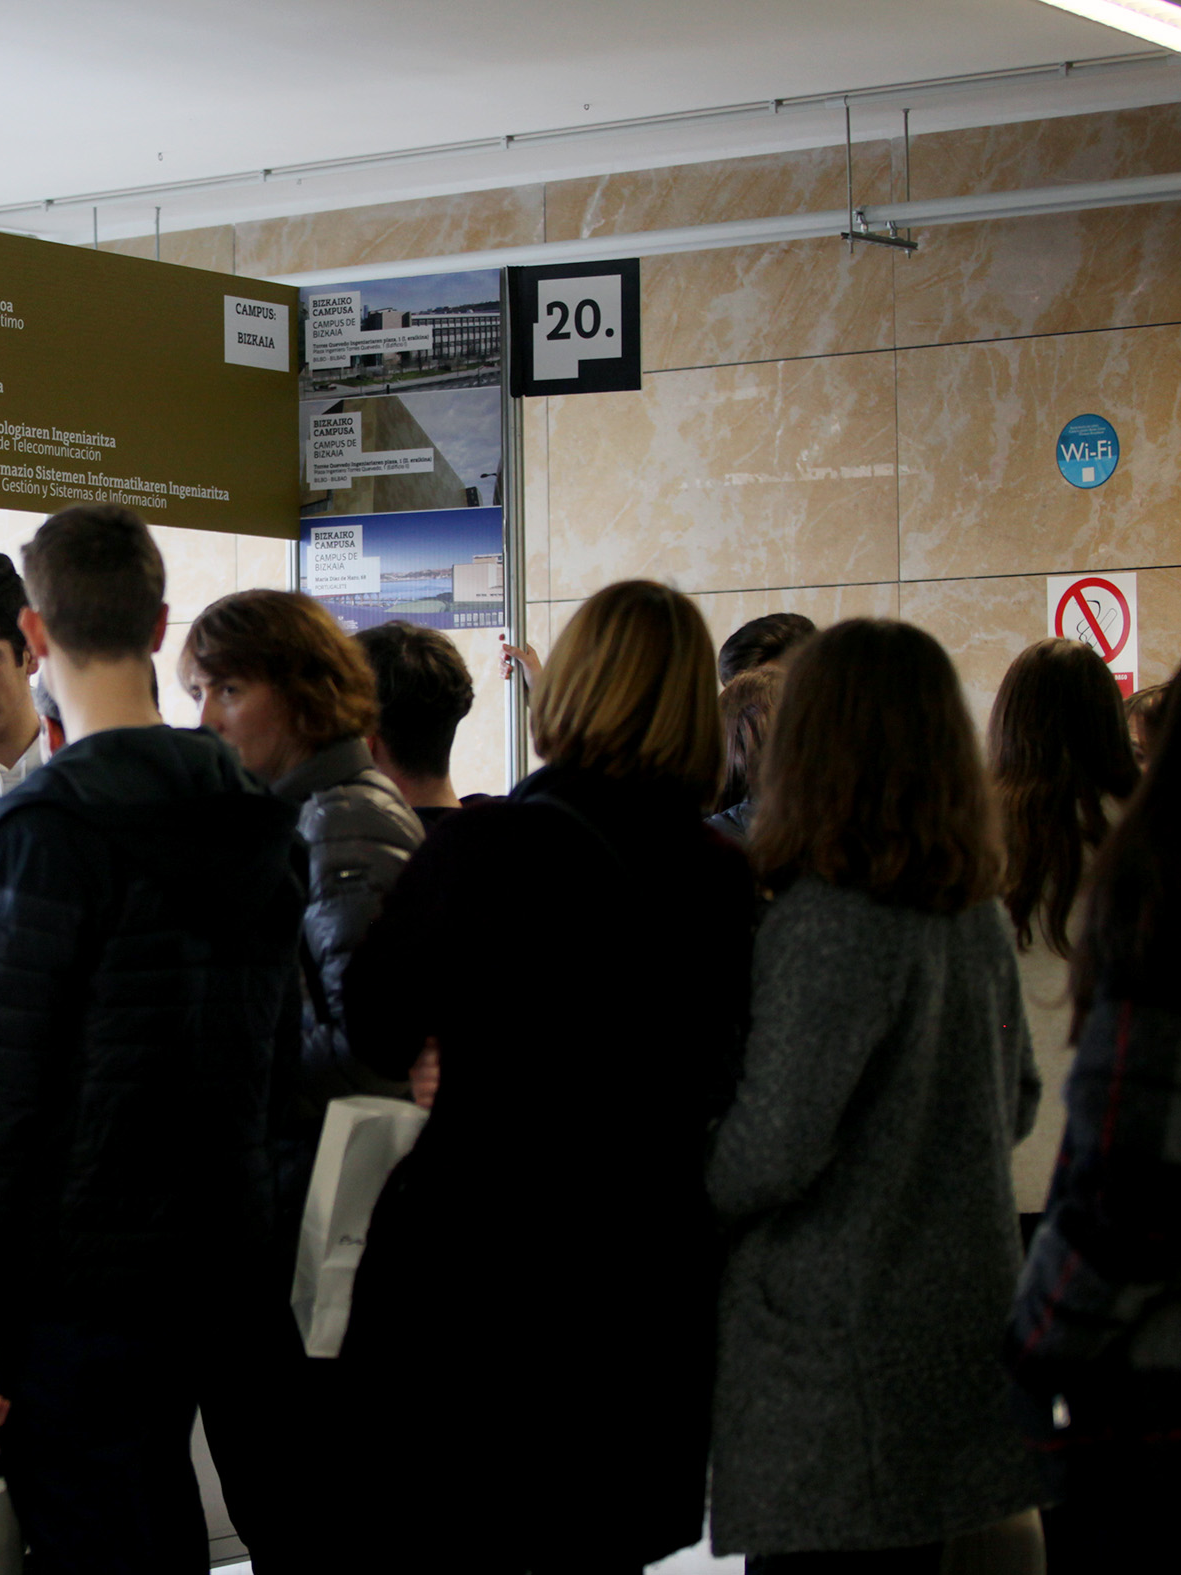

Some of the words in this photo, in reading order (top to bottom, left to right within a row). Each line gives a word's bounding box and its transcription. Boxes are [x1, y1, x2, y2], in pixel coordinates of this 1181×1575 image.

[312, 297, 352, 308] BIZKAIKO
[235, 302, 276, 320] CAMPUS:
[312, 306, 353, 317] CAMPUSA
[312, 319, 345, 329] CAMPUS
[345, 318, 356, 327] DE
[546, 298, 615, 341] 20.
[312, 328, 343, 338] BIZKAIA
[237, 331, 276, 349] BIZKAIA
[313, 418, 353, 428] BIZKAIKO
[51, 426, 116, 448] Ingeniaritza
[313, 427, 354, 437] CAMPUSA
[12, 437, 102, 461] Telecomunicación
[313, 439, 346, 450] CAMPUS
[347, 439, 357, 447] DE
[313, 449, 344, 459] BIZKAIA
[1060, 440, 1112, 462] Wi-Fi
[35, 465, 86, 485] Sistemen
[87, 471, 167, 495] Informatikaren
[168, 481, 230, 501] Ingeniaritza
[1, 477, 40, 495] Gestión
[41, 485, 48, 499] y
[49, 482, 94, 501] Sistemas
[95, 488, 108, 503] de
[109, 489, 167, 509] Información
[314, 531, 355, 540] BIZKAIKO
[314, 540, 356, 550] CAMPUSA
[315, 553, 347, 562] CAMPUS
[347, 552, 358, 561] DE
[315, 562, 345, 571] BIZKAIA
